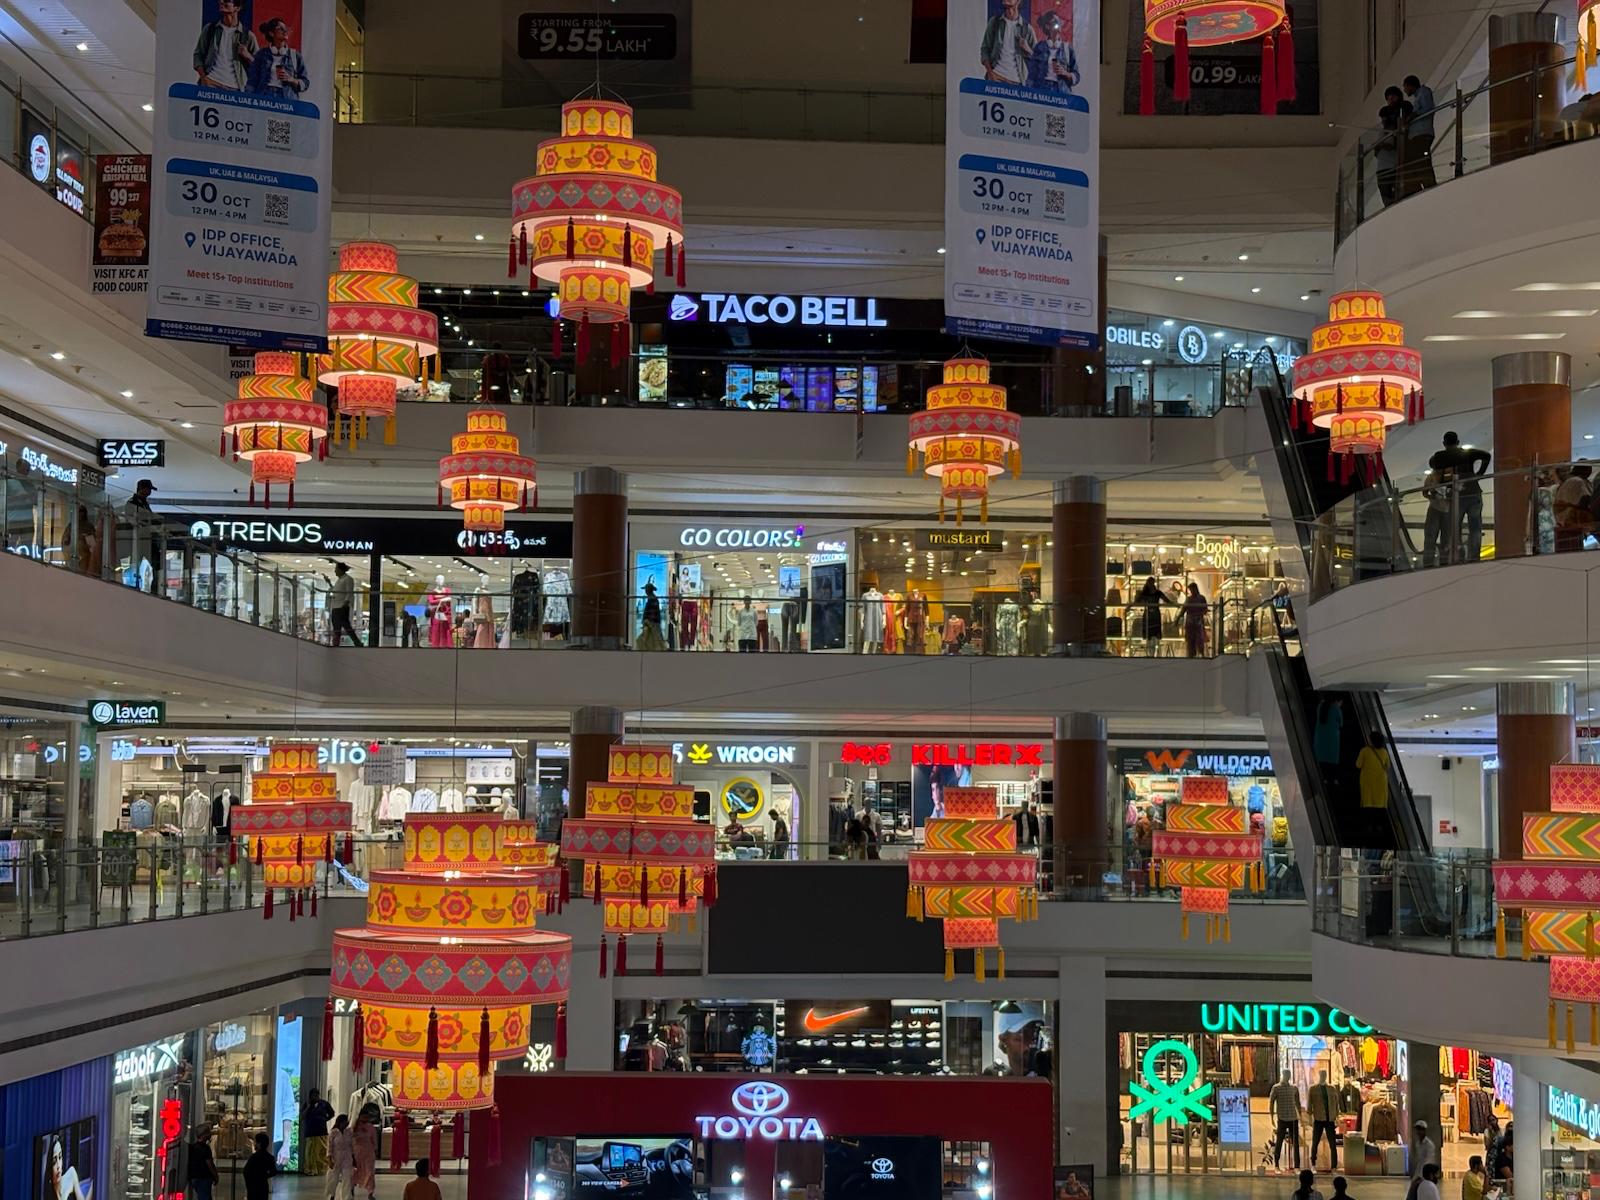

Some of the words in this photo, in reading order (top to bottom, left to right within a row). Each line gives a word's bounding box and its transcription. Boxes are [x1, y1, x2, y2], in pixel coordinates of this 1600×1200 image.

[532, 19, 579, 27] STARTING
[583, 19, 612, 27] FROM
[197, 90, 236, 102] AUSTRALIA,
[239, 96, 251, 105] UAE
[260, 100, 294, 112] MALAYSIA
[1021, 91, 1033, 100] UAE
[1039, 94, 1068, 106] MALAYSIA
[189, 105, 220, 128] 16
[225, 120, 253, 134] OCT
[978, 100, 1005, 123] 16
[1009, 115, 1034, 129] OCT
[193, 131, 203, 140] 12
[205, 133, 219, 142] PM
[227, 135, 233, 143] 4
[235, 136, 249, 145] PM
[982, 126, 991, 135] 12
[993, 128, 1005, 137] PM
[1011, 131, 1017, 139] 4
[1018, 131, 1030, 140] PM
[104, 165, 146, 174] CHICKEN
[116, 157, 134, 165] KFC
[222, 168, 236, 178] UAE
[243, 171, 279, 184] MALAYSIA
[1008, 164, 1020, 174] UAE
[1026, 167, 1056, 179] MALAYSIA
[182, 180, 217, 203] 30
[222, 195, 251, 208] OCT
[973, 176, 1004, 199] 30
[1009, 191, 1033, 204] OCT
[191, 206, 201, 215] 12
[203, 207, 217, 216] PM
[224, 210, 231, 218] 4
[233, 211, 247, 220] PM
[981, 202, 990, 211] 12
[992, 204, 1004, 213] PM
[1017, 207, 1030, 216] PM
[202, 228, 226, 241] IDP
[229, 231, 285, 251] OFFICE,
[991, 225, 1012, 237] IDP
[1016, 228, 1062, 247] OFFICE,
[202, 244, 298, 266] VIJAYAWADA
[991, 240, 1073, 262] VIJAYAWADA
[94, 269, 116, 279] VISIT
[118, 269, 136, 279] KFC
[137, 269, 149, 279] AT
[187, 269, 210, 280] Meet
[212, 271, 226, 281] 15+
[228, 274, 243, 285] Top
[244, 275, 294, 289] Institutions
[978, 266, 999, 277] Meet
[999, 268, 1012, 277] 15+
[1014, 270, 1026, 281] Top
[1027, 272, 1070, 286] Institutions
[93, 282, 116, 292] FOOD
[118, 282, 149, 292] COURT
[701, 294, 796, 323] TACO
[801, 297, 887, 327] BELL
[231, 360, 250, 368] VISIT
[103, 442, 158, 459] SASS
[213, 521, 322, 543] TRENDS
[323, 540, 373, 550] WOMAN
[680, 528, 711, 546] GO
[929, 530, 990, 545] mustard
[717, 745, 794, 763] WROGN
[912, 744, 1012, 766] KILLER
[1197, 755, 1273, 771] WILDCRA
[910, 1007, 939, 1015] LIFESTYLE
[1201, 1003, 1320, 1032] UNITED
[1549, 1085, 1578, 1126] health
[1579, 1098, 1588, 1130] &
[696, 1116, 824, 1141] TOYOTA
